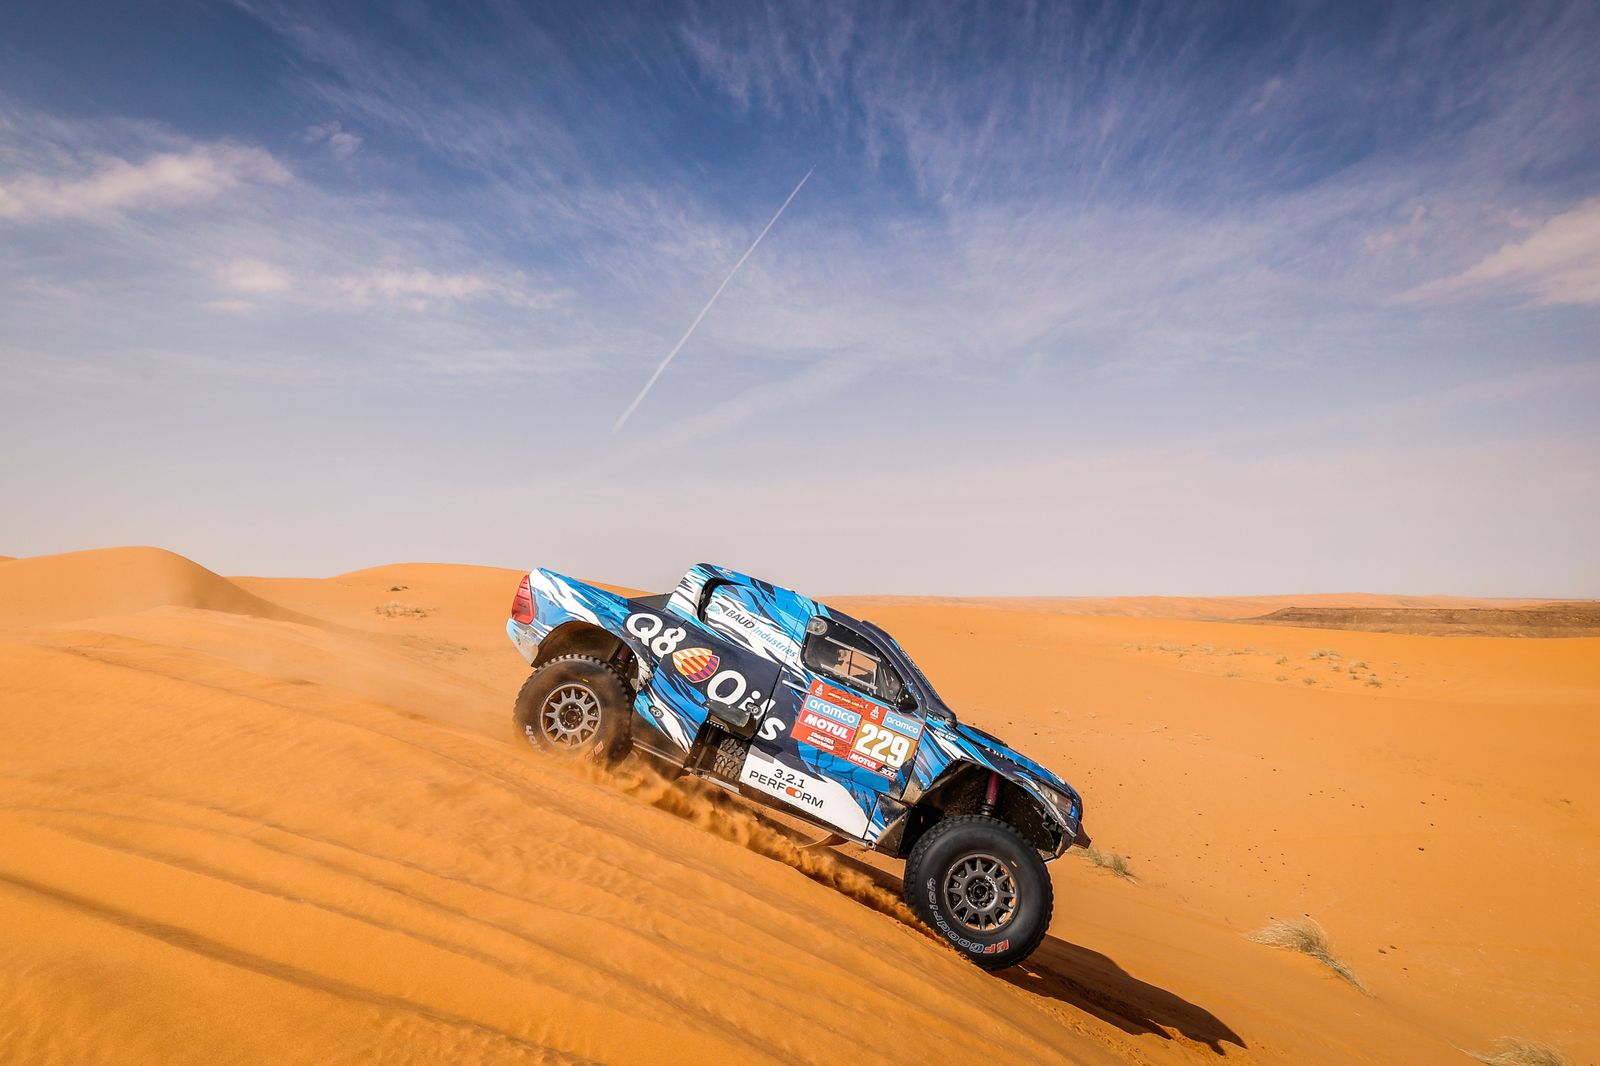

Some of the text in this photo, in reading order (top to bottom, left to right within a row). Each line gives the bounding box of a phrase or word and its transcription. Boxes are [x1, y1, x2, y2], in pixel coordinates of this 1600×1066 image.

[726, 610, 798, 658] BAUD Industries
[626, 613, 786, 741] Q8 Oils
[803, 714, 848, 739] MOTUL
[809, 699, 856, 724] aramco
[886, 714, 919, 734] aramco
[849, 753, 877, 770] MOTUL
[854, 723, 910, 768] 229
[749, 770, 824, 809] PERFORM
[774, 768, 805, 789] 3.2.1
[926, 877, 1010, 954] BFGoodrich
